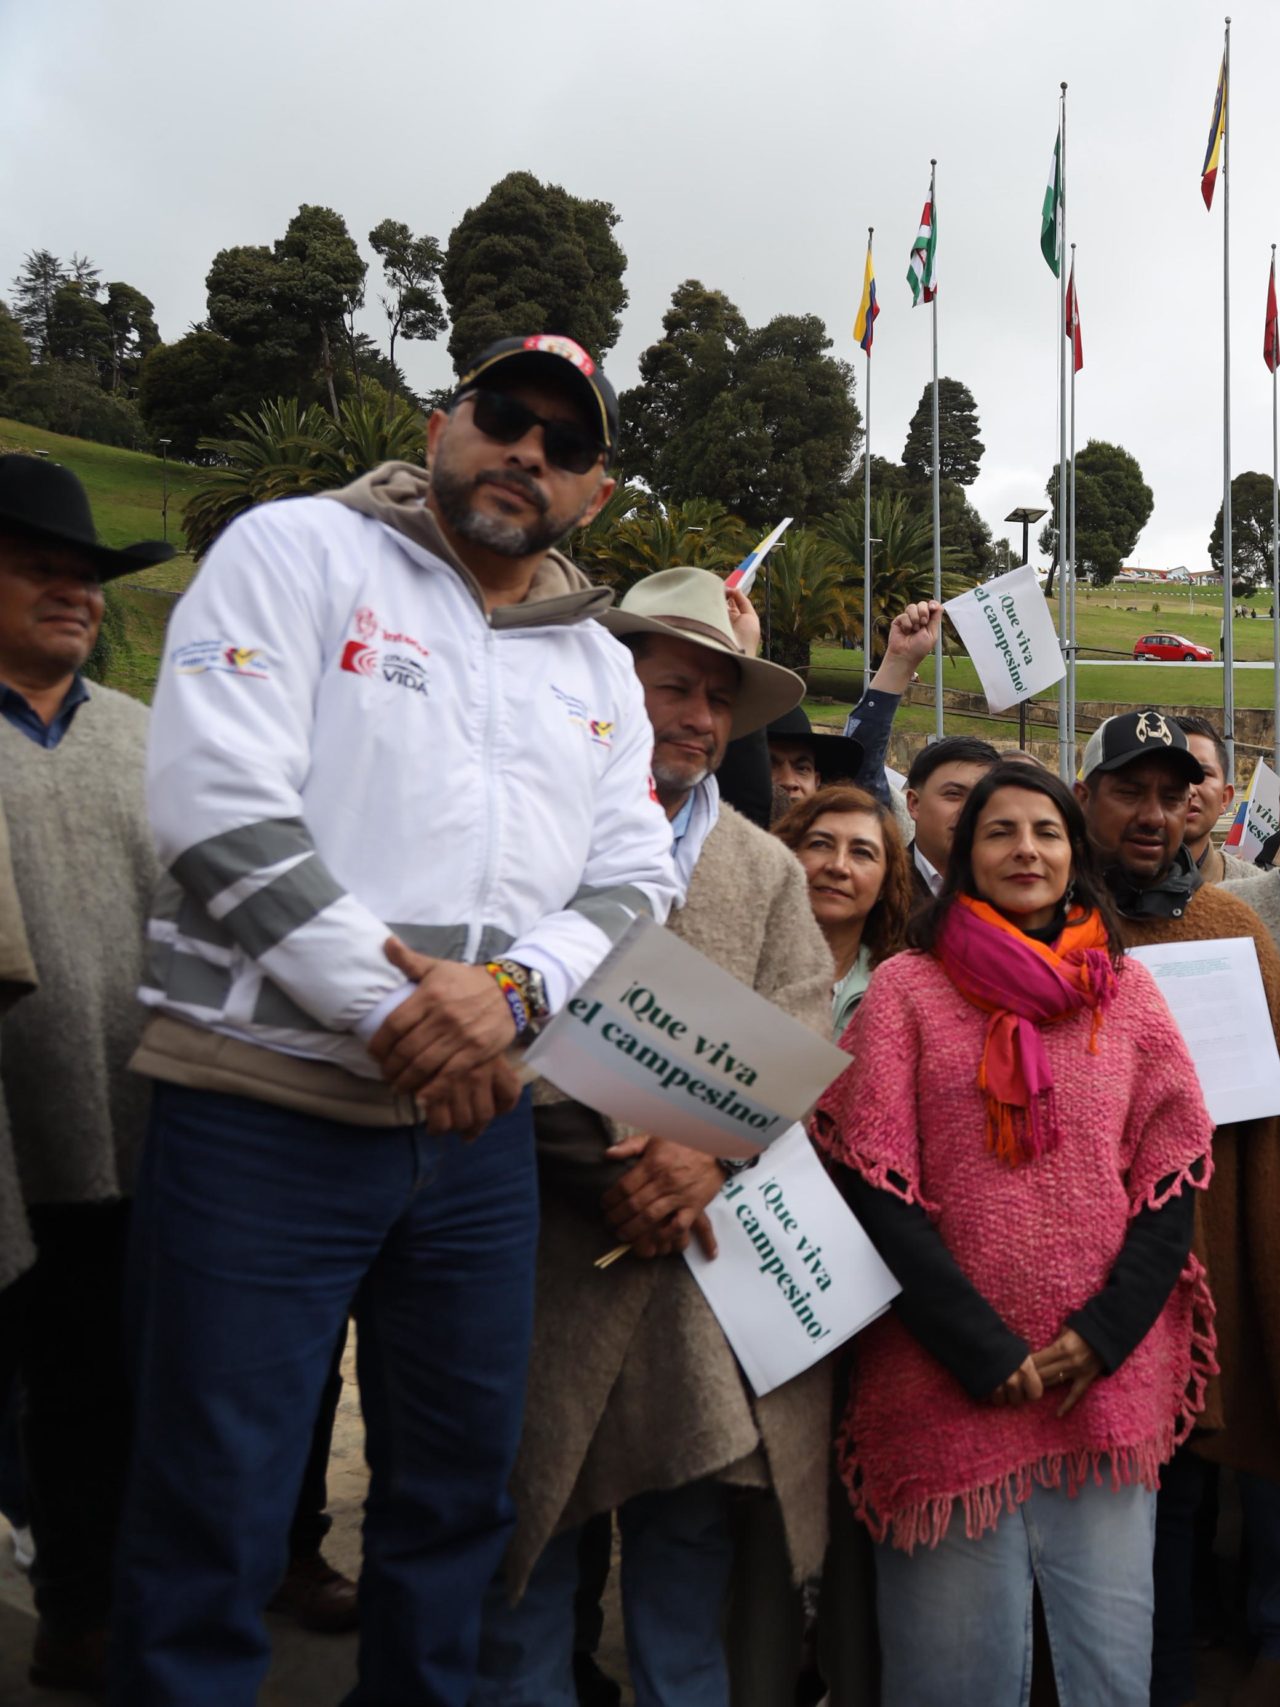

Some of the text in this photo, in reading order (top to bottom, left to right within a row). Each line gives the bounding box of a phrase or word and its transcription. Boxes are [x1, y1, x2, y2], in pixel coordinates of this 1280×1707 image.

[974, 588, 1028, 694] el campesino!
[999, 592, 1033, 666] ¡Que viva
[383, 670, 428, 697] VIDA
[1256, 804, 1280, 832] viva
[568, 998, 604, 1026] el
[601, 1022, 780, 1133] campesino!
[620, 981, 758, 1088] ¡Que viva
[736, 1204, 832, 1344] campesino!
[758, 1176, 832, 1292] ¡Que viva
